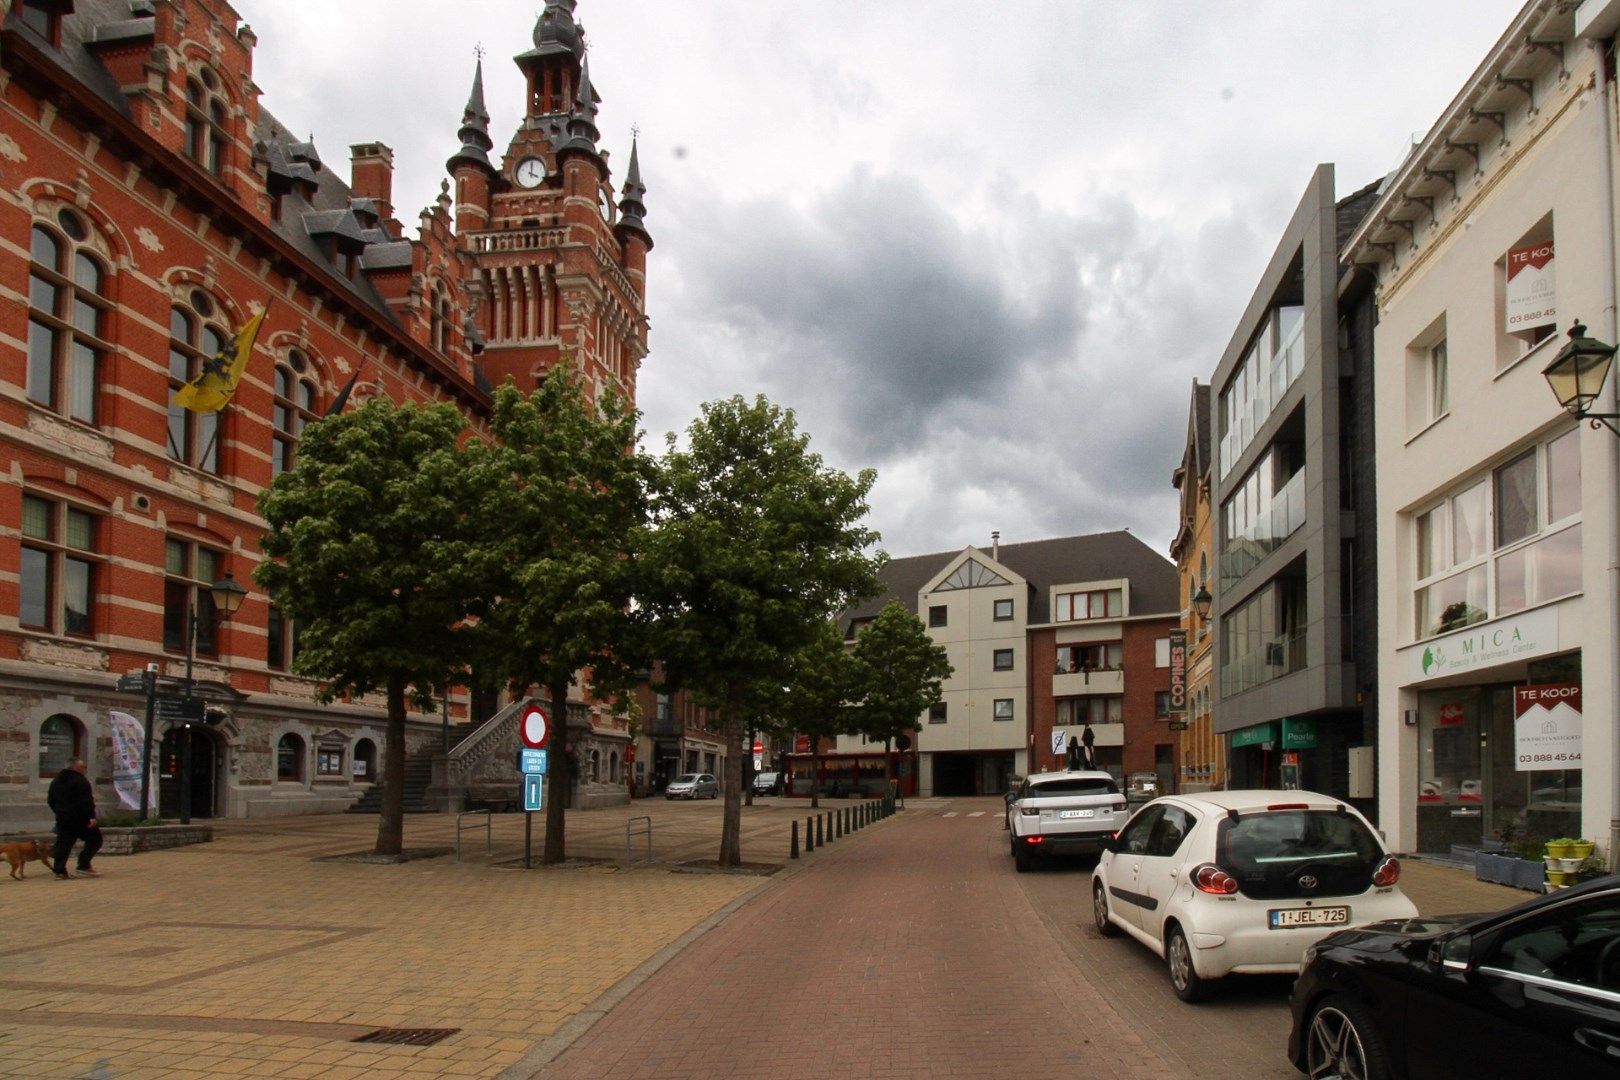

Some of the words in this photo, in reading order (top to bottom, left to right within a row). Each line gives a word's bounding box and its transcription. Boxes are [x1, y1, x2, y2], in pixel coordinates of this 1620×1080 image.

[1512, 252, 1528, 263] TE
[1509, 316, 1522, 324] 03
[1523, 311, 1542, 321] 888
[1543, 308, 1556, 317] 45
[1462, 626, 1522, 655] MICA
[1171, 646, 1185, 707] COPINES
[1520, 690, 1537, 700] TE
[1540, 687, 1579, 698] KOOP
[1287, 732, 1314, 741] Pearle
[1519, 755, 1532, 763] 03
[1534, 754, 1552, 762] 888
[1554, 753, 1567, 761] 45
[1569, 752, 1582, 760] 64
